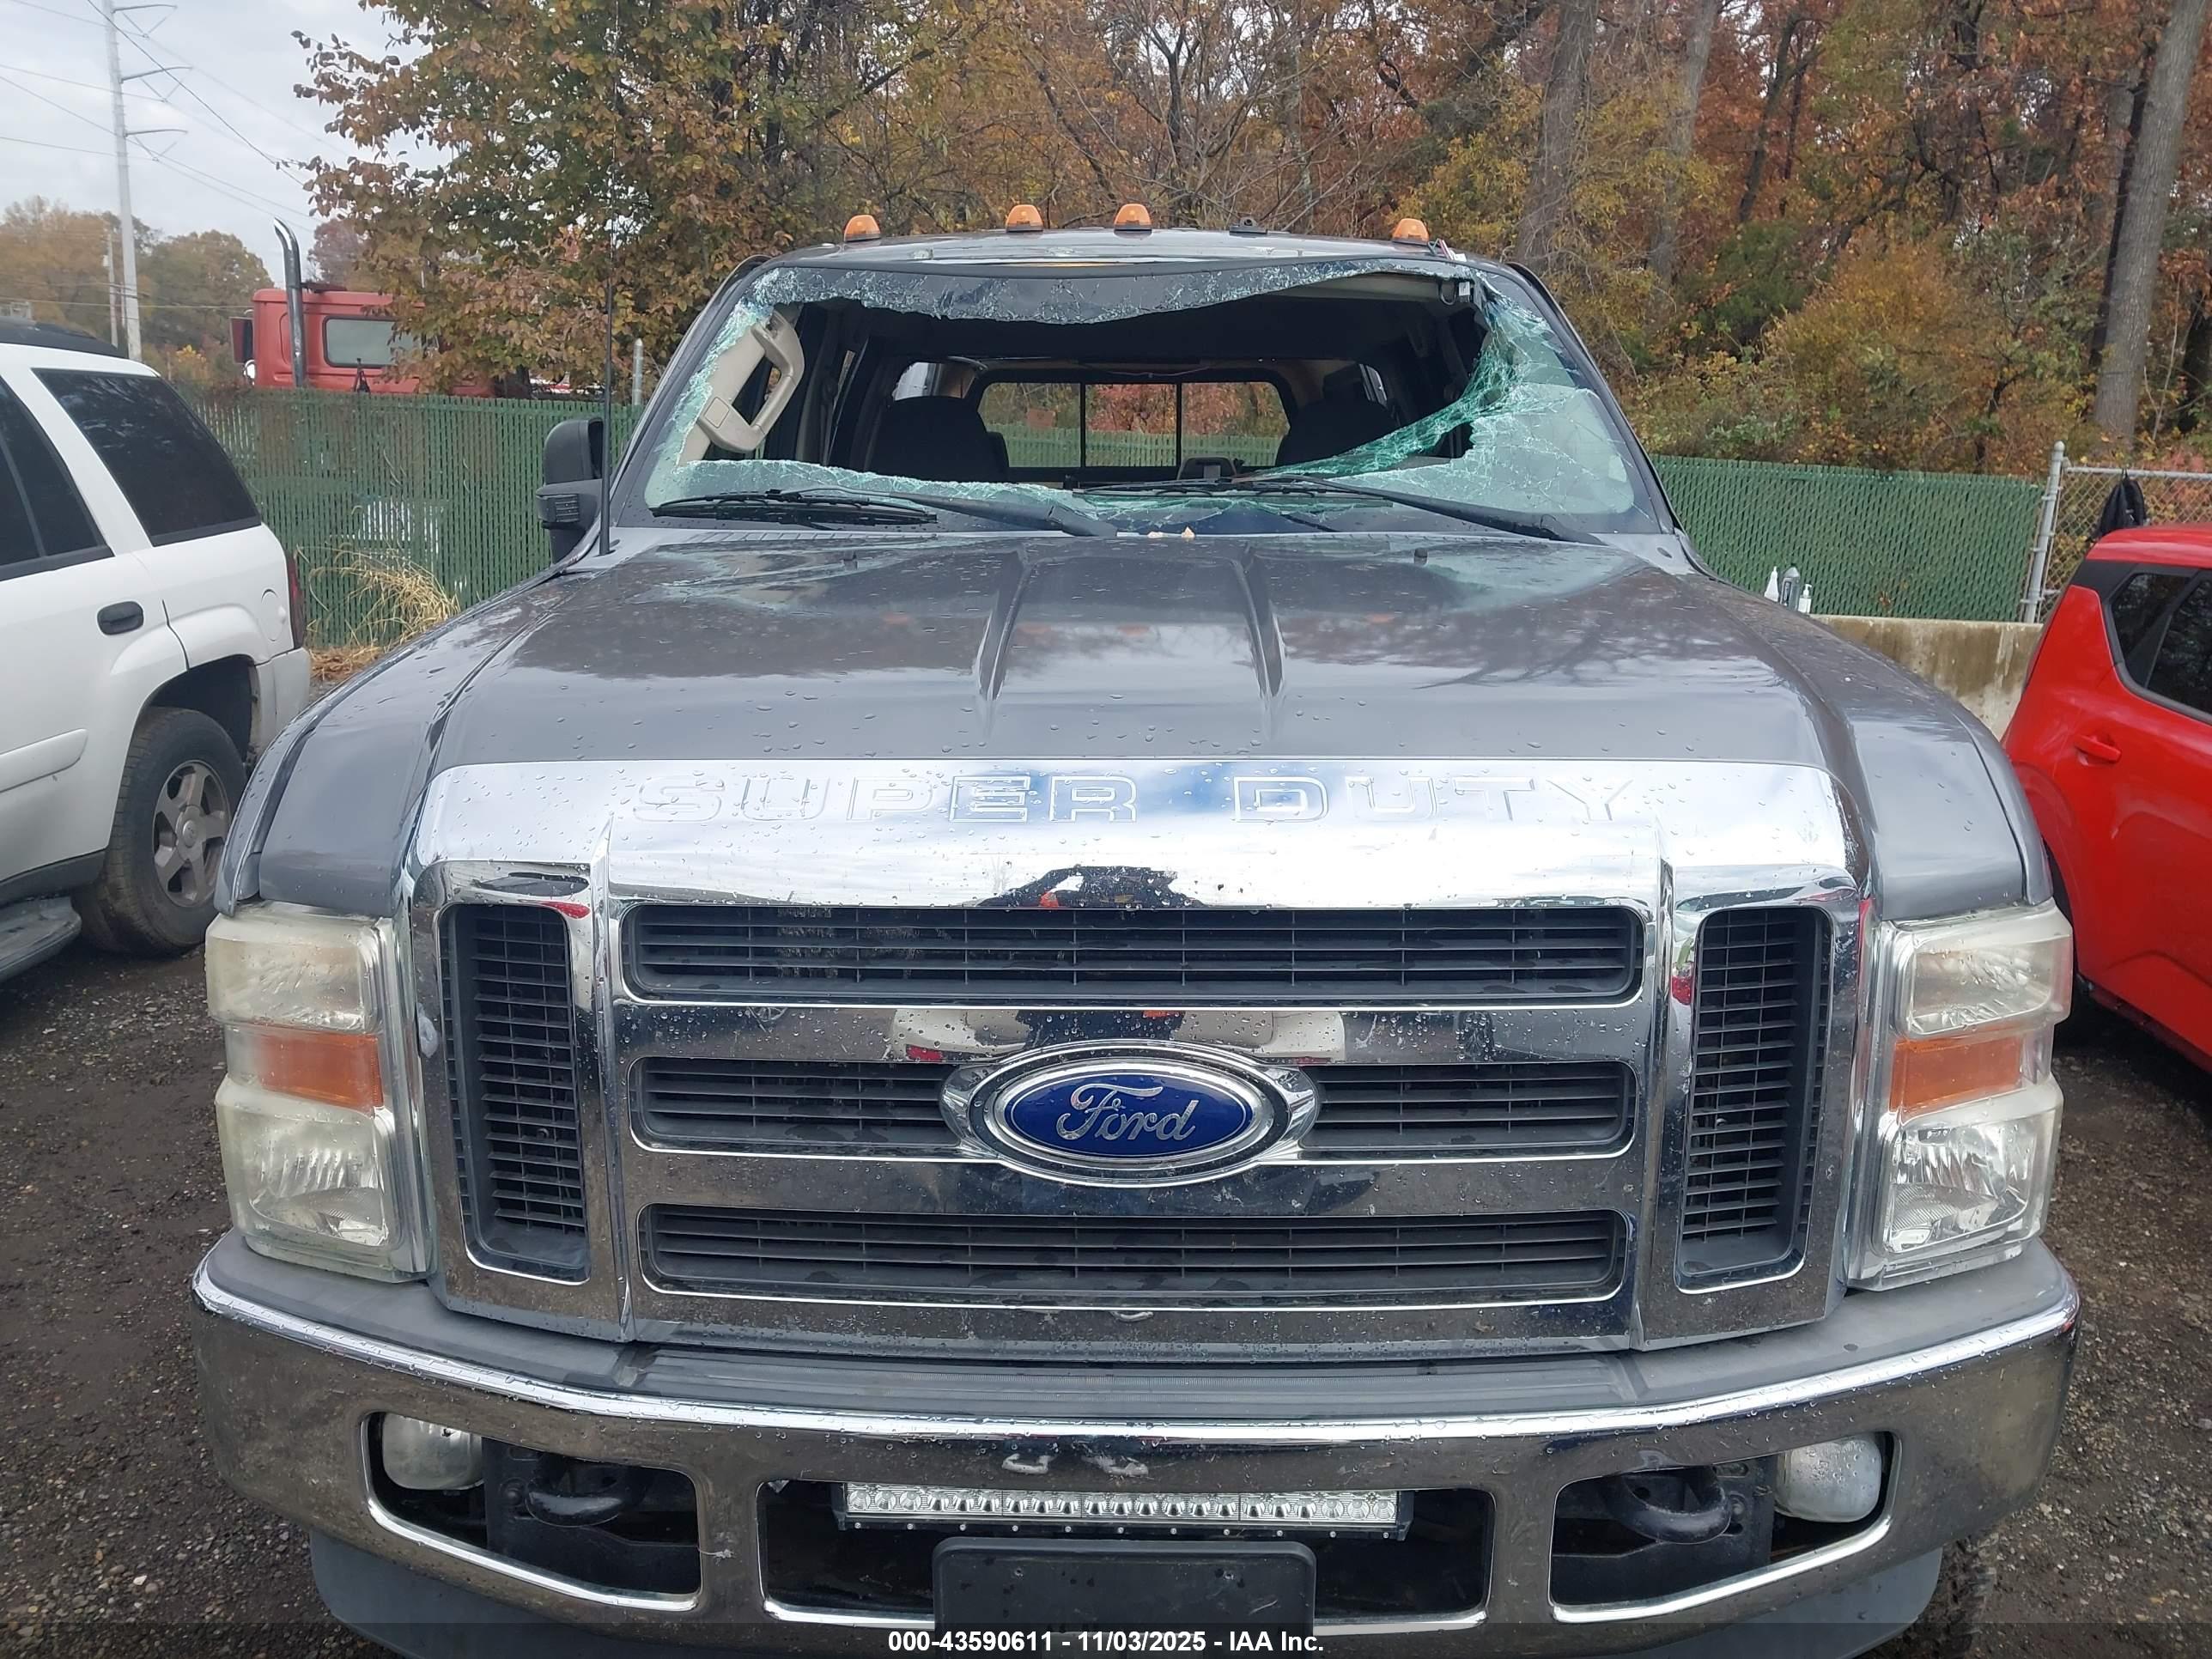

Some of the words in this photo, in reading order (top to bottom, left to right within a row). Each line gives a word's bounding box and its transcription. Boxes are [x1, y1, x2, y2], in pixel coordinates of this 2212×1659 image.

[633, 775, 1137, 822] SUPER
[1231, 775, 1633, 822] DUTY
[1055, 1083, 1200, 1141] Ford
